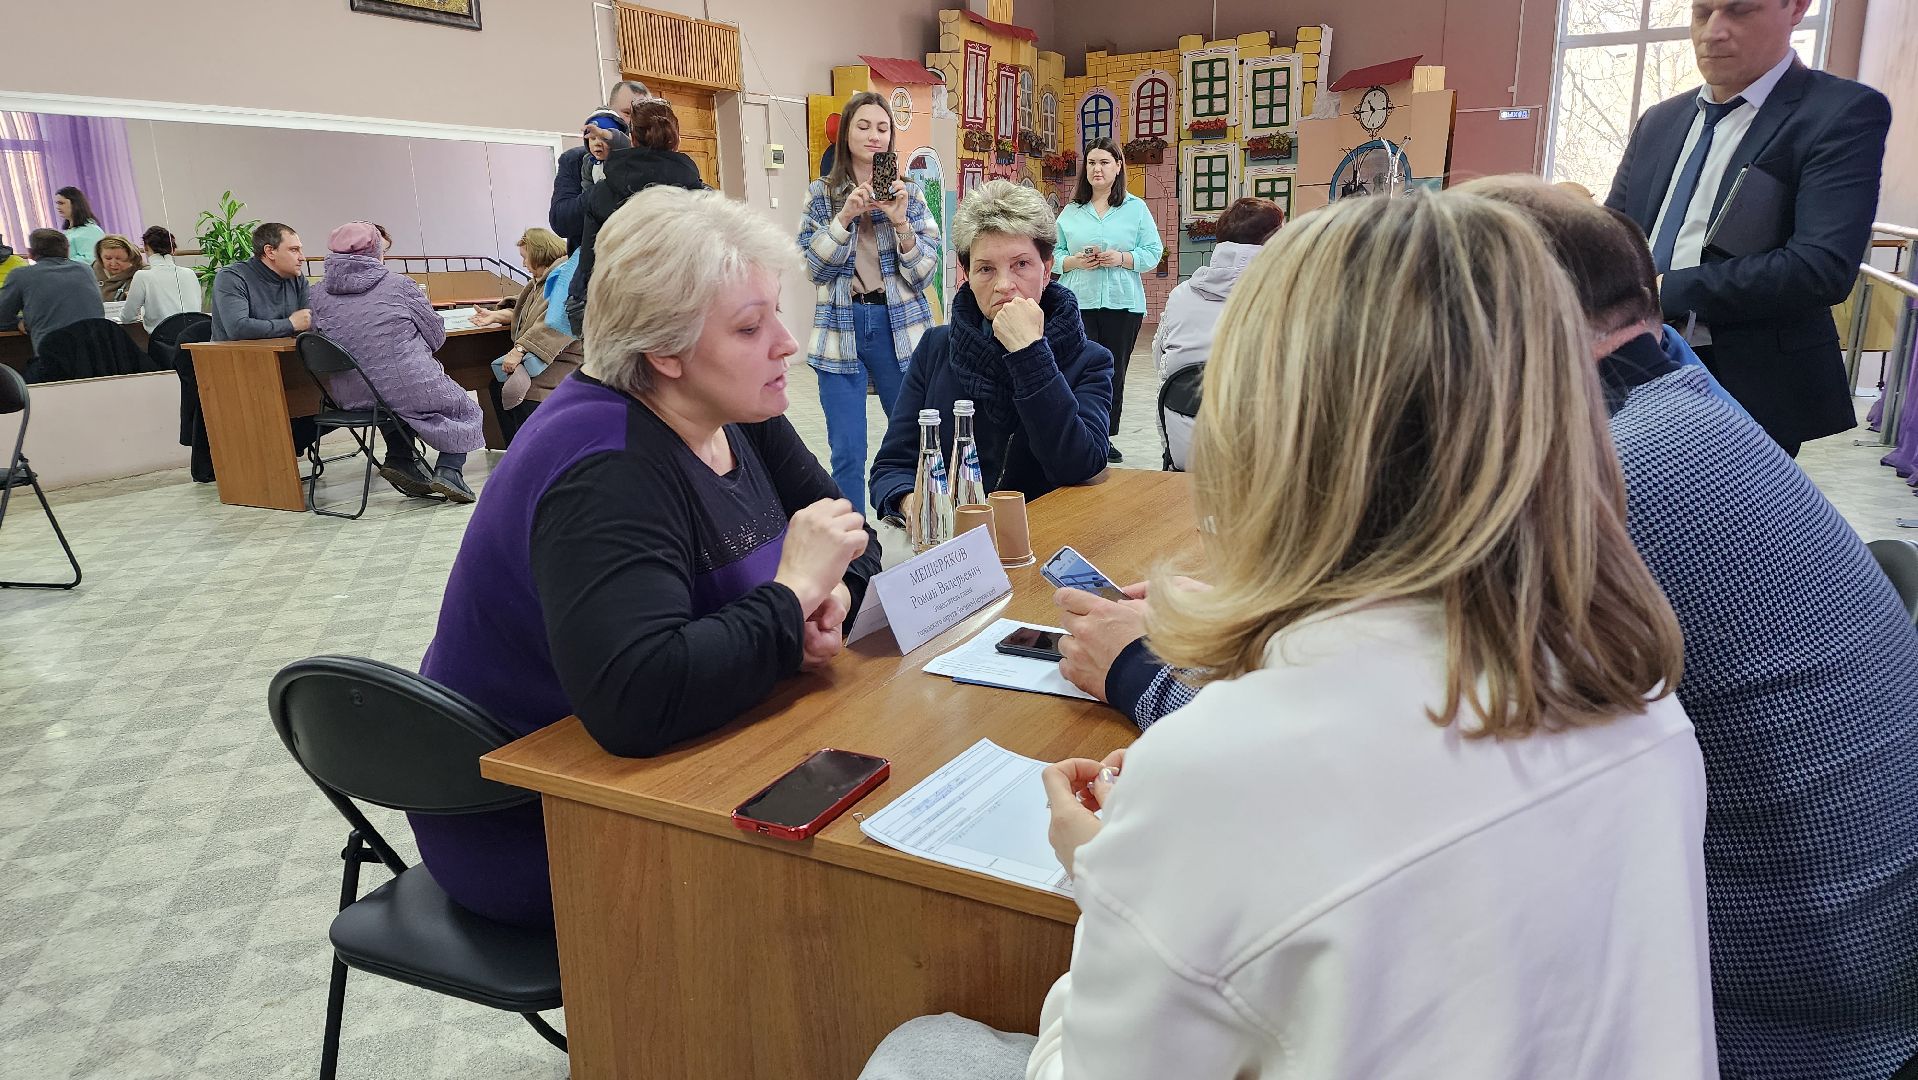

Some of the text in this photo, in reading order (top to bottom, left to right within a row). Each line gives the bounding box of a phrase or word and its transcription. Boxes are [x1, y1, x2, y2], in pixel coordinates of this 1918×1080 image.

[910, 547, 968, 585] МЕЩЕРЯКОВ
[910, 588, 938, 609] Роман
[936, 565, 982, 595] Валерьевич
